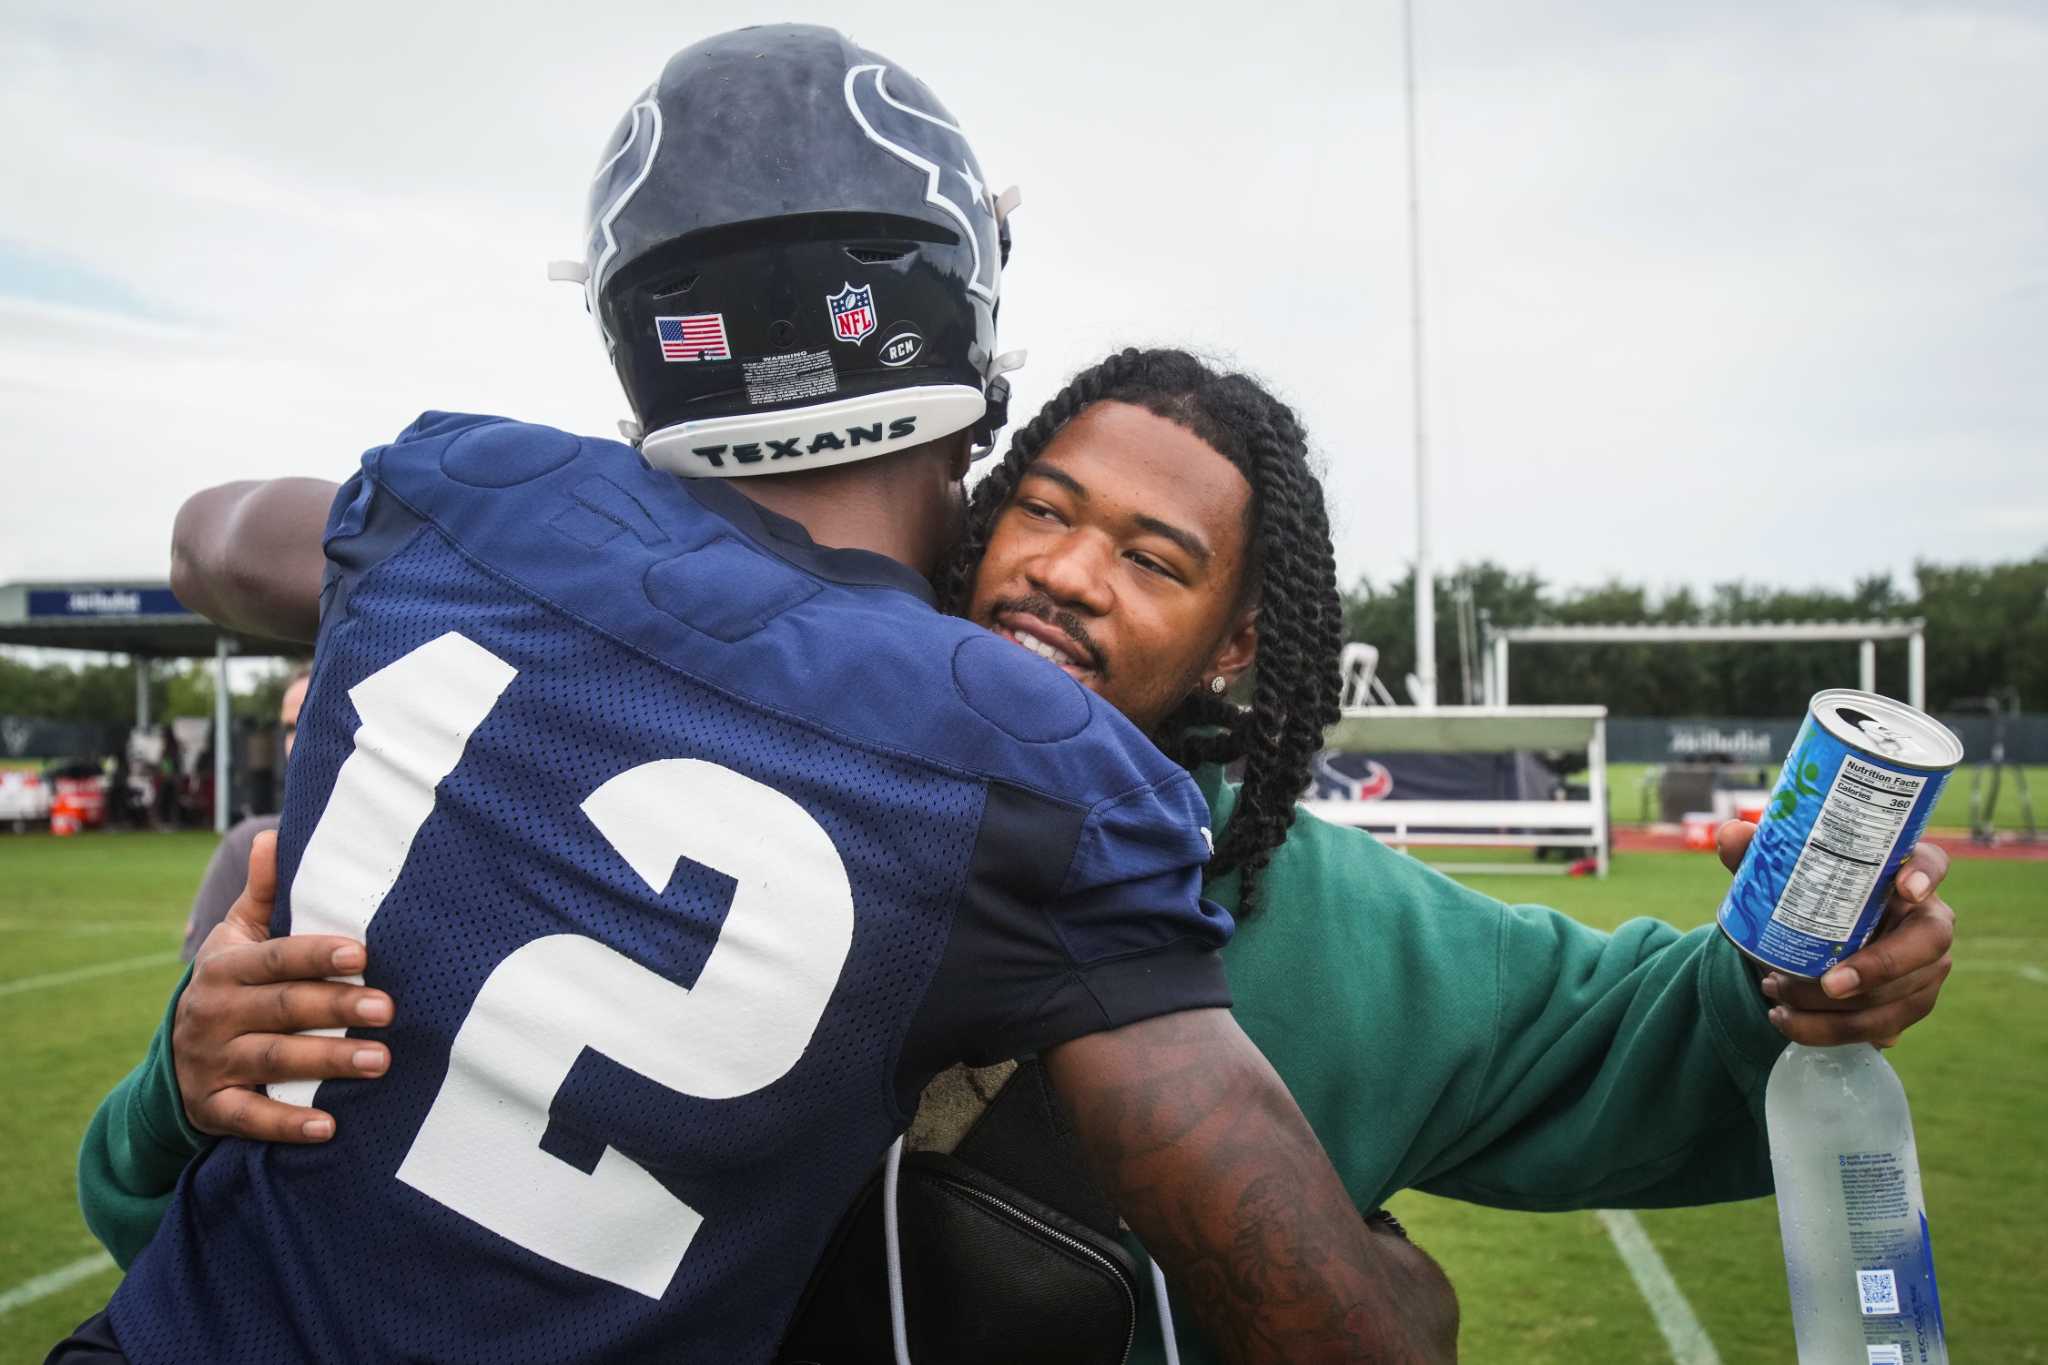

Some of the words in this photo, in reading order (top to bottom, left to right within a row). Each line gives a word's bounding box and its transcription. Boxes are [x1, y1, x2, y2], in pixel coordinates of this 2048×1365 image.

[837, 309, 872, 336] NFL
[762, 350, 808, 362] WARNING
[889, 339, 915, 362] RCM
[691, 416, 918, 468] TEXANS
[1846, 760, 1891, 783] Nutrition
[1894, 777, 1921, 788] Facts
[1837, 781, 1873, 801] Calories
[1889, 798, 1911, 809] 360
[267, 630, 856, 1300] 12
